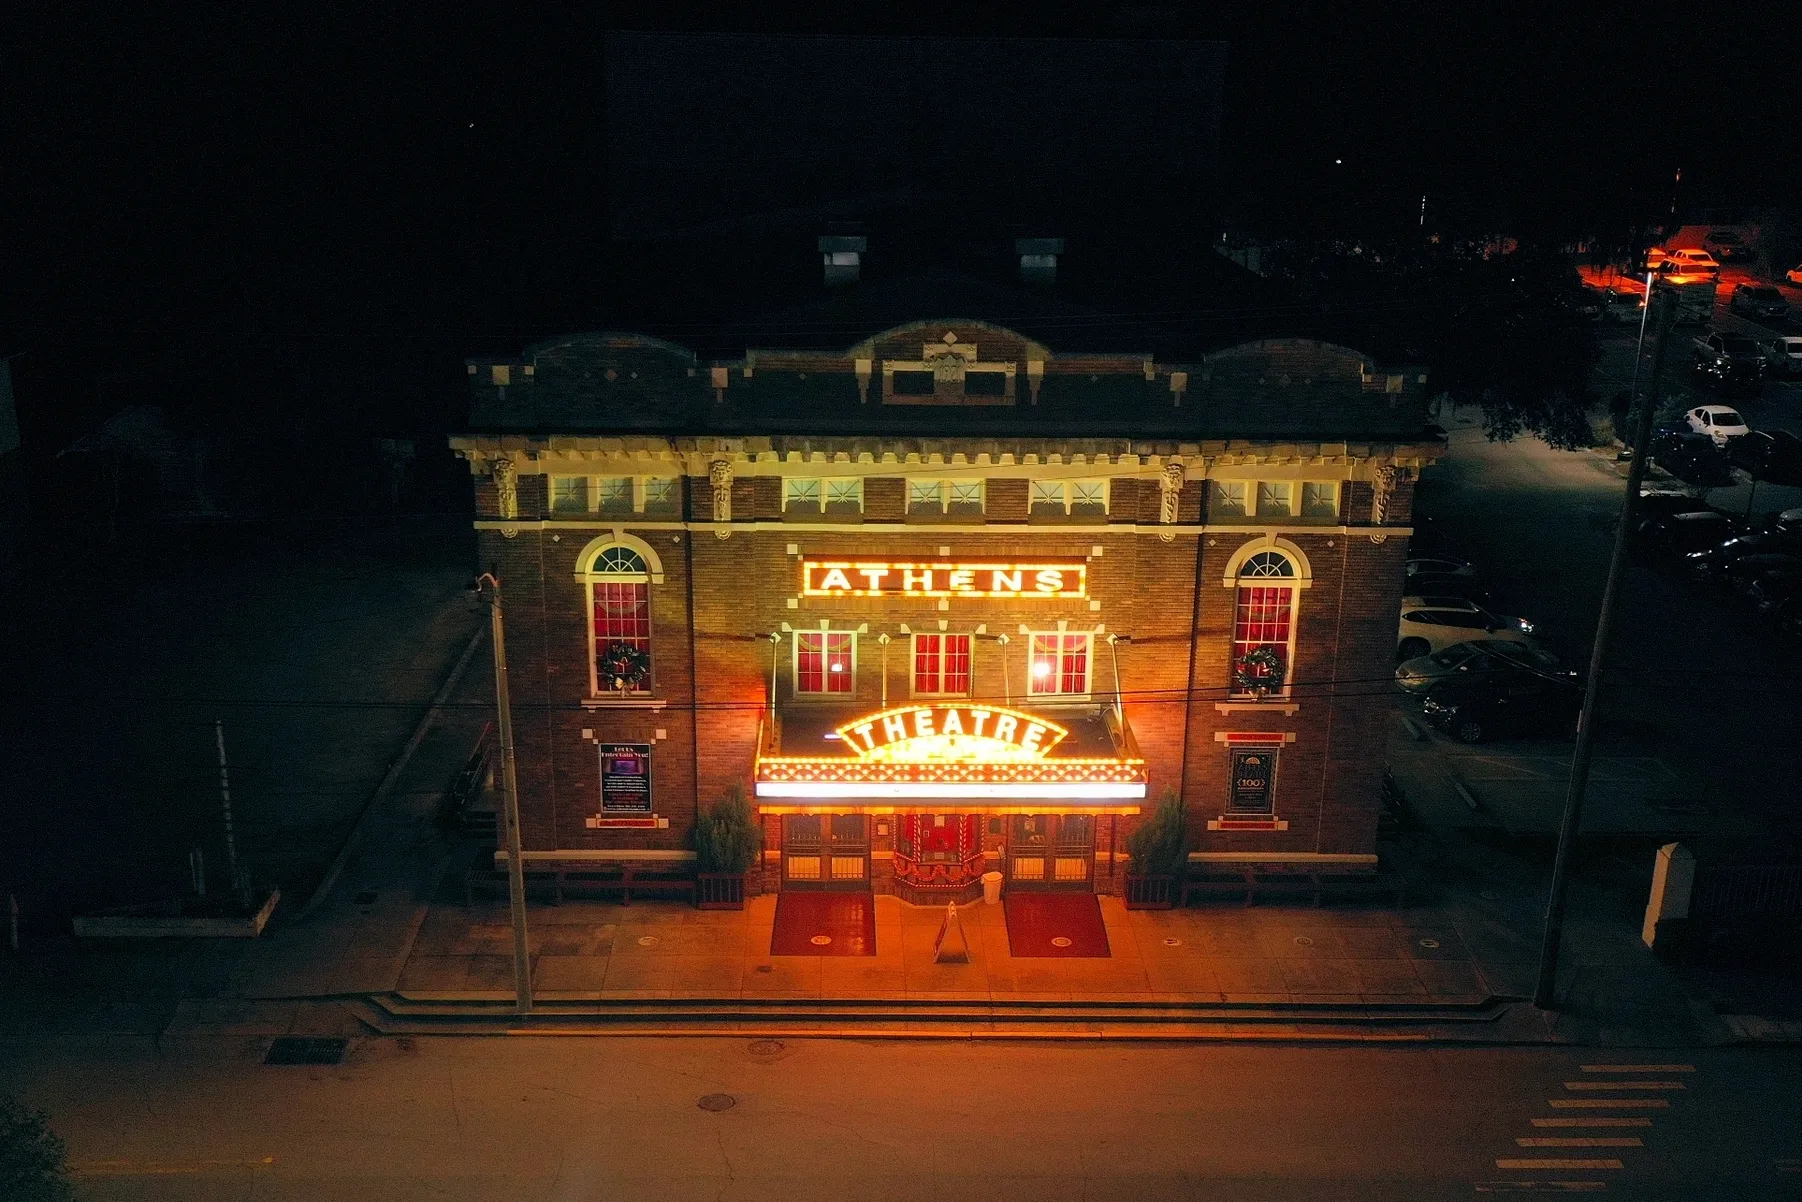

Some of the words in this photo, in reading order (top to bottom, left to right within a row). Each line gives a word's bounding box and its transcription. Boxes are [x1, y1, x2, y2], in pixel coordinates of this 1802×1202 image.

[821, 568, 1064, 592] ATHENS
[855, 710, 1049, 751] THEATRE
[1242, 779, 1260, 787] 100
